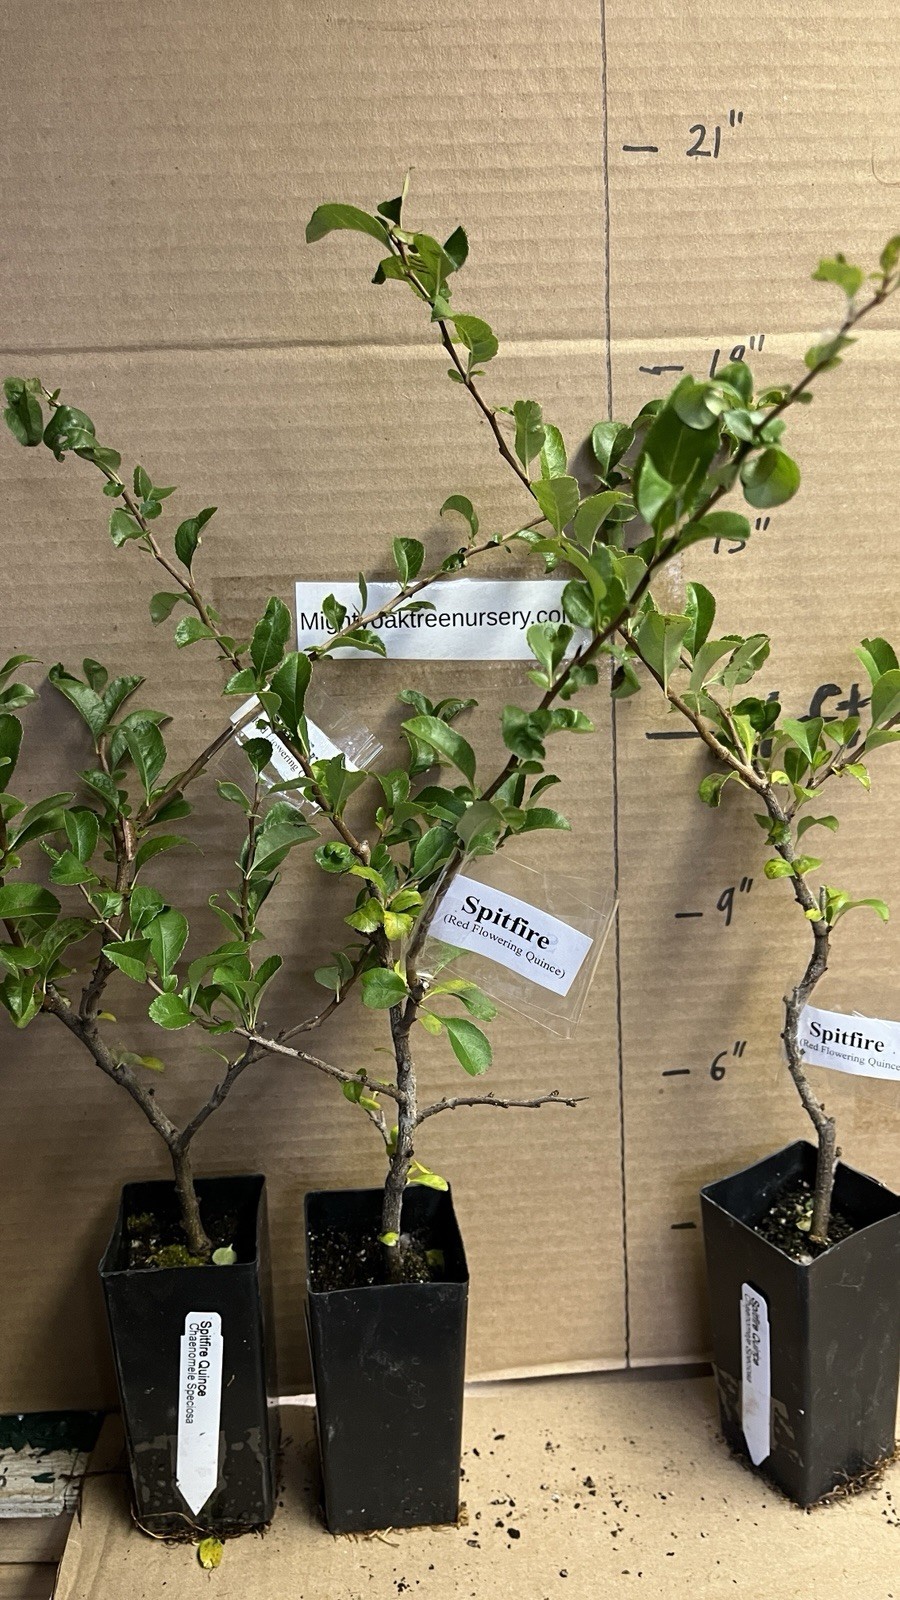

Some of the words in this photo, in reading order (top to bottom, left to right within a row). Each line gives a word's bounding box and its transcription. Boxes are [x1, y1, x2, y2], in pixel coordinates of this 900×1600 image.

[686, 109, 744, 158] 21"
[716, 876, 754, 926] 9"
[461, 895, 550, 950] Spitfire
[443, 914, 469, 930] (Red
[471, 924, 523, 957] Flowering
[525, 950, 566, 979] Quince)
[800, 1038, 819, 1051] (Red
[821, 1045, 865, 1065] Flowering
[809, 1021, 885, 1053] Spitfire
[709, 1040, 747, 1081] 6"
[187, 1323, 199, 1381] Chaenomele
[199, 1320, 212, 1358] Spitfire
[197, 1360, 211, 1397] Quince
[185, 1382, 197, 1424] Speciosa
